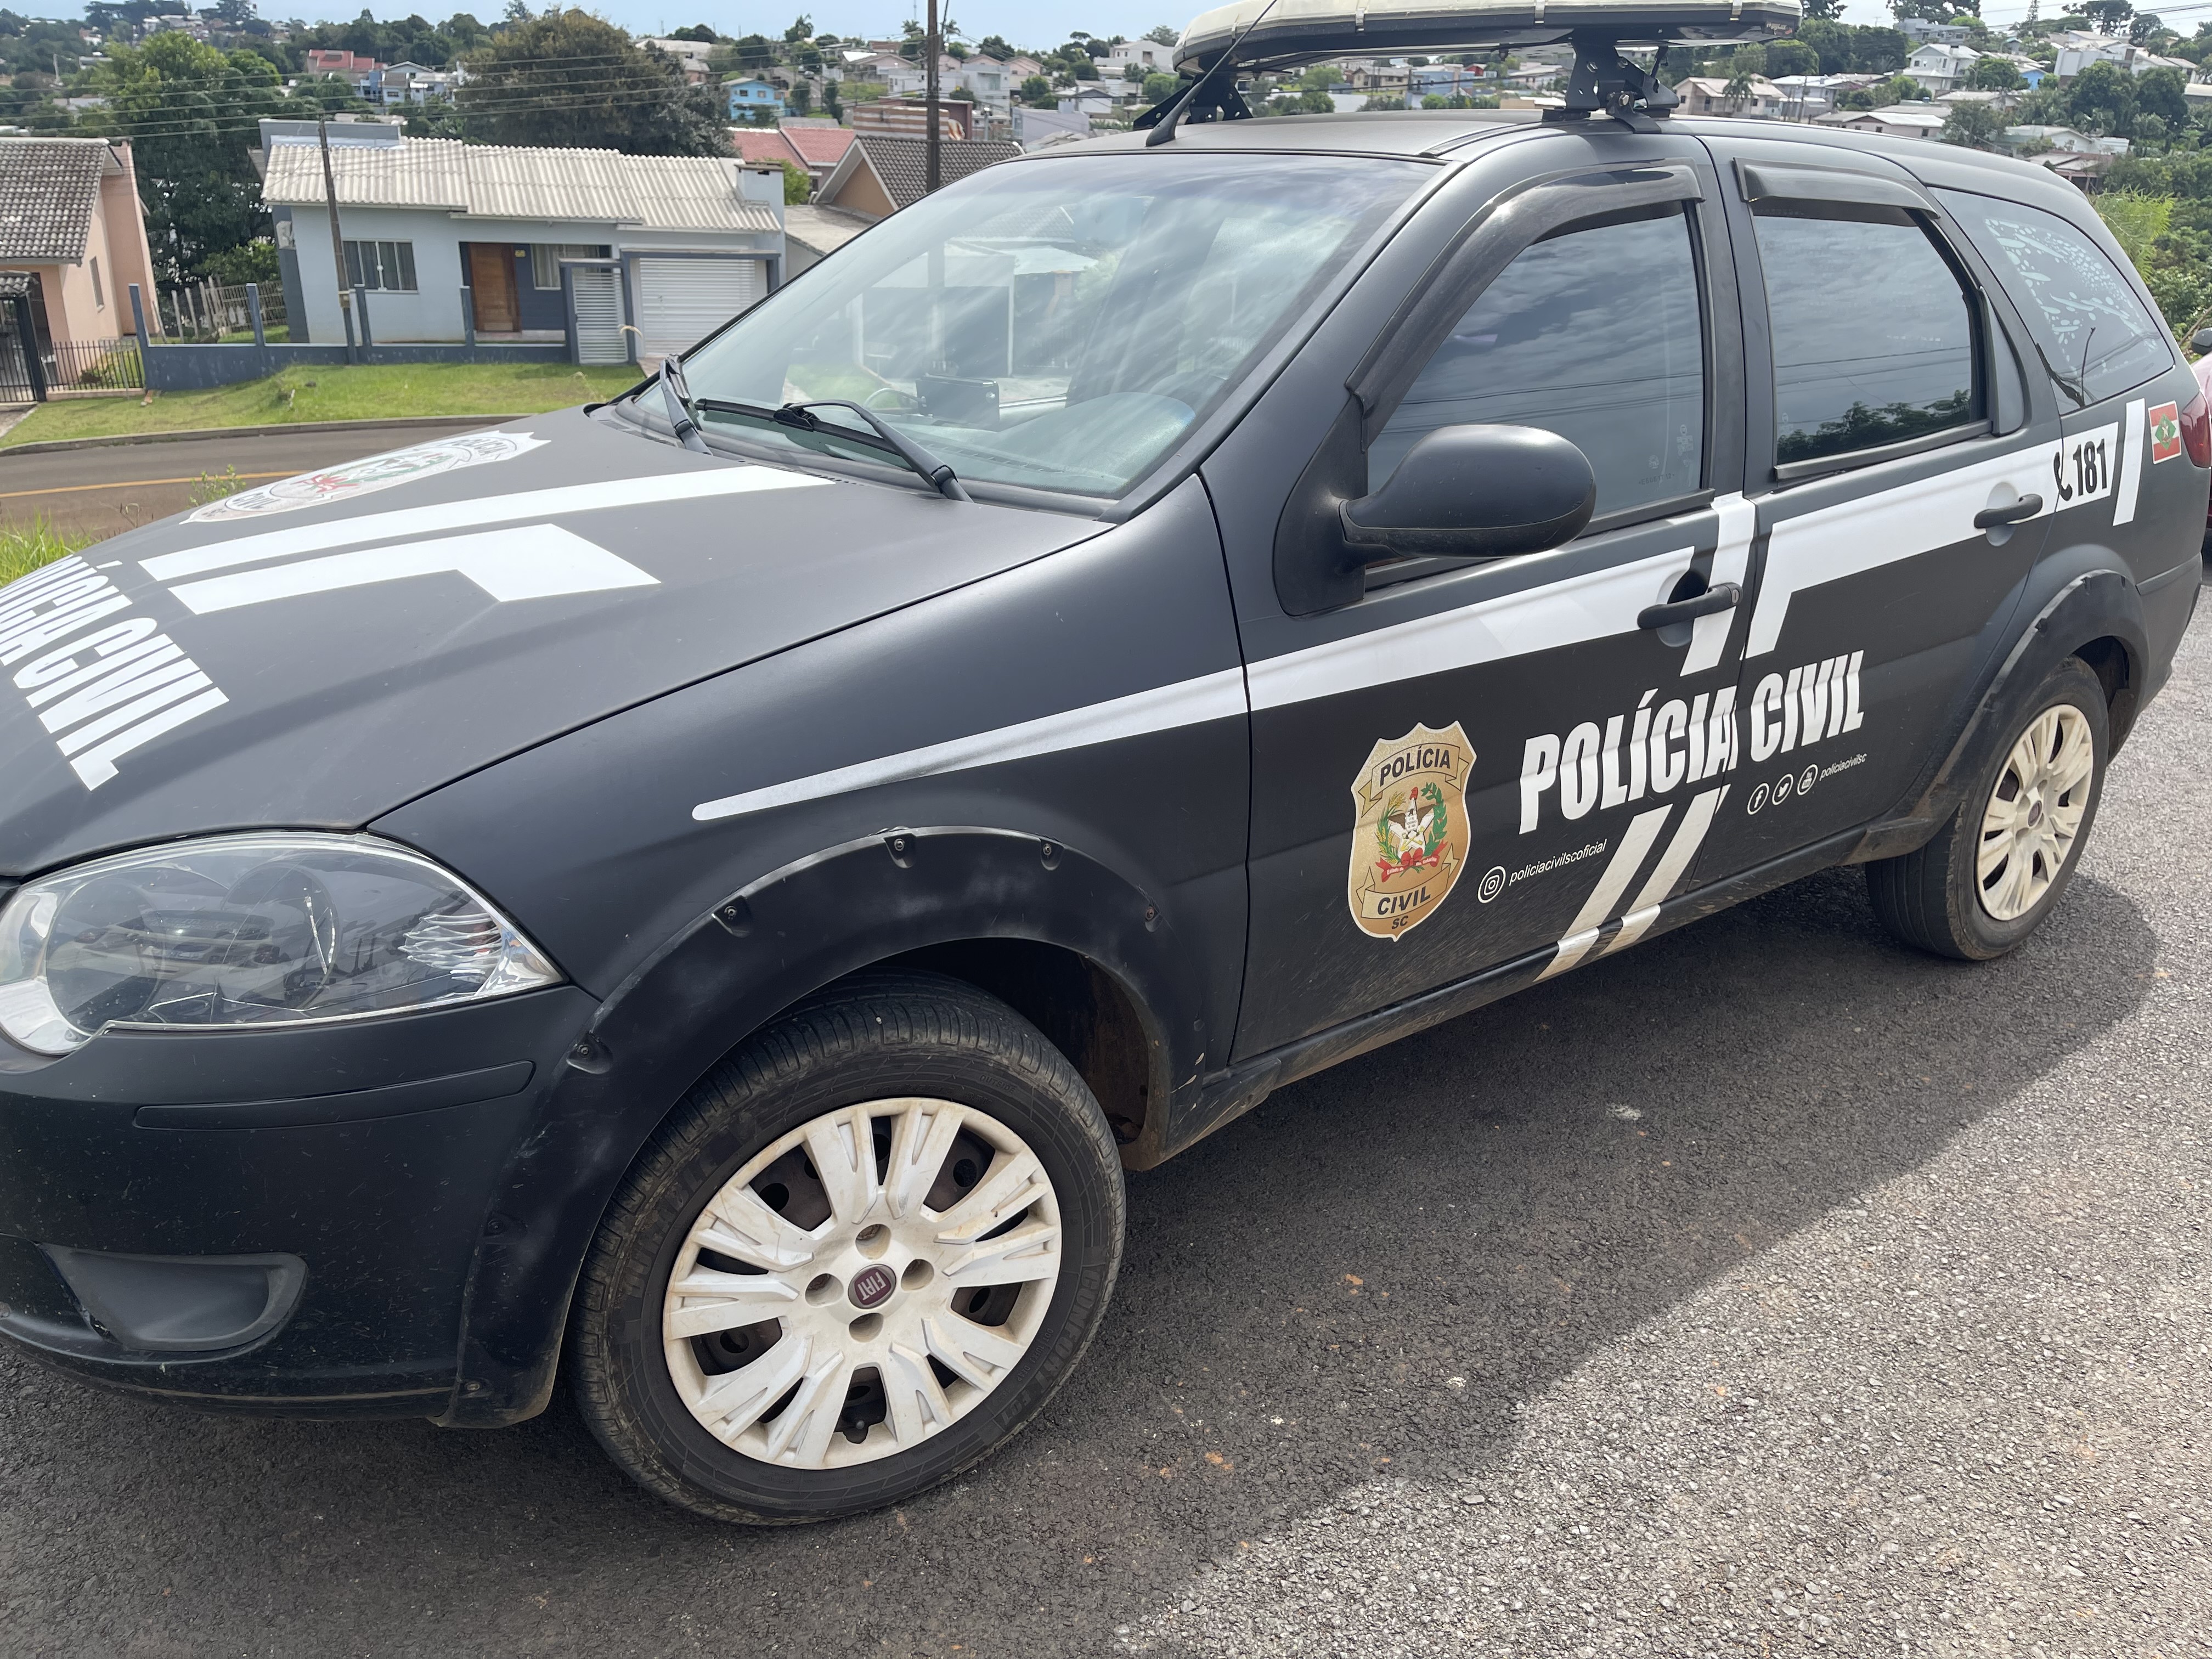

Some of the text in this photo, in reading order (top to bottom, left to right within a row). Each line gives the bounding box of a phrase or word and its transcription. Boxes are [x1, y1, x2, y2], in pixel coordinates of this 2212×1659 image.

[2073, 438, 2107, 496] 181
[13, 617, 230, 791] CIVIL
[1519, 650, 1865, 835] POLÍCIA CIVIL
[1379, 745, 1451, 787] POLÍCIA
[1819, 753, 1867, 782] policiacivilsc
[1509, 838, 1607, 887] policiacivilscoficial
[1377, 885, 1431, 915] CIVIL
[1391, 915, 1409, 930] SC
[979, 1074, 1015, 1094] OUTSIDE
[857, 1271, 887, 1301] FIAT
[1043, 1328, 1054, 1343] DOT
